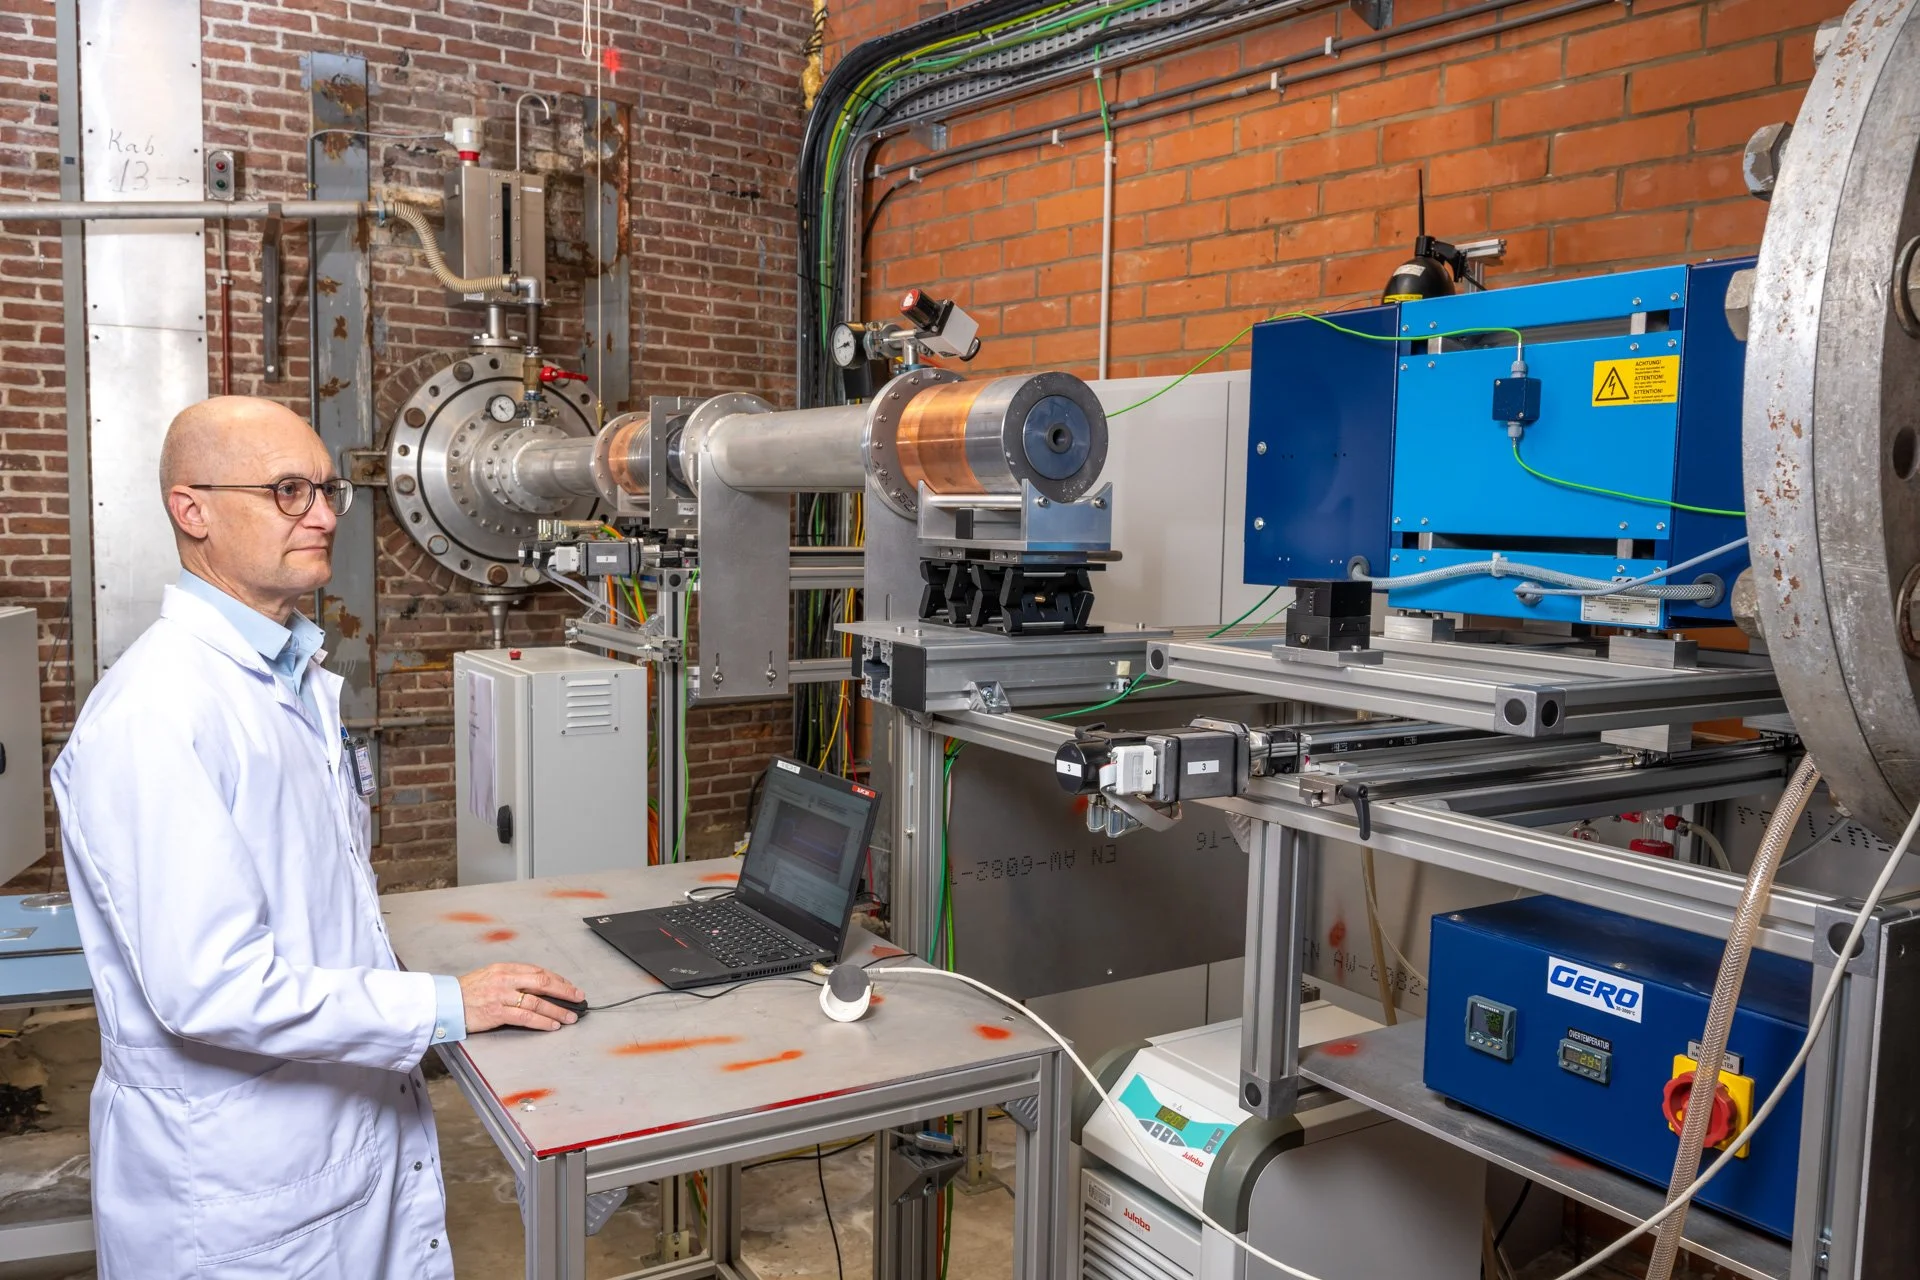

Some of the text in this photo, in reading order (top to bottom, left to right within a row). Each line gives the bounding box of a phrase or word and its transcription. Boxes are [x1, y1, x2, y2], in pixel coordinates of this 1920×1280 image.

[109, 159, 149, 192] 13
[1201, 763, 1207, 771] 3
[1092, 844, 1116, 866] EN
[1550, 965, 1640, 1009] GERO
[1568, 1029, 1610, 1051] OVERTEMPERATUR
[1182, 1152, 1204, 1167] Julabo
[1123, 1208, 1151, 1232] Julabo
